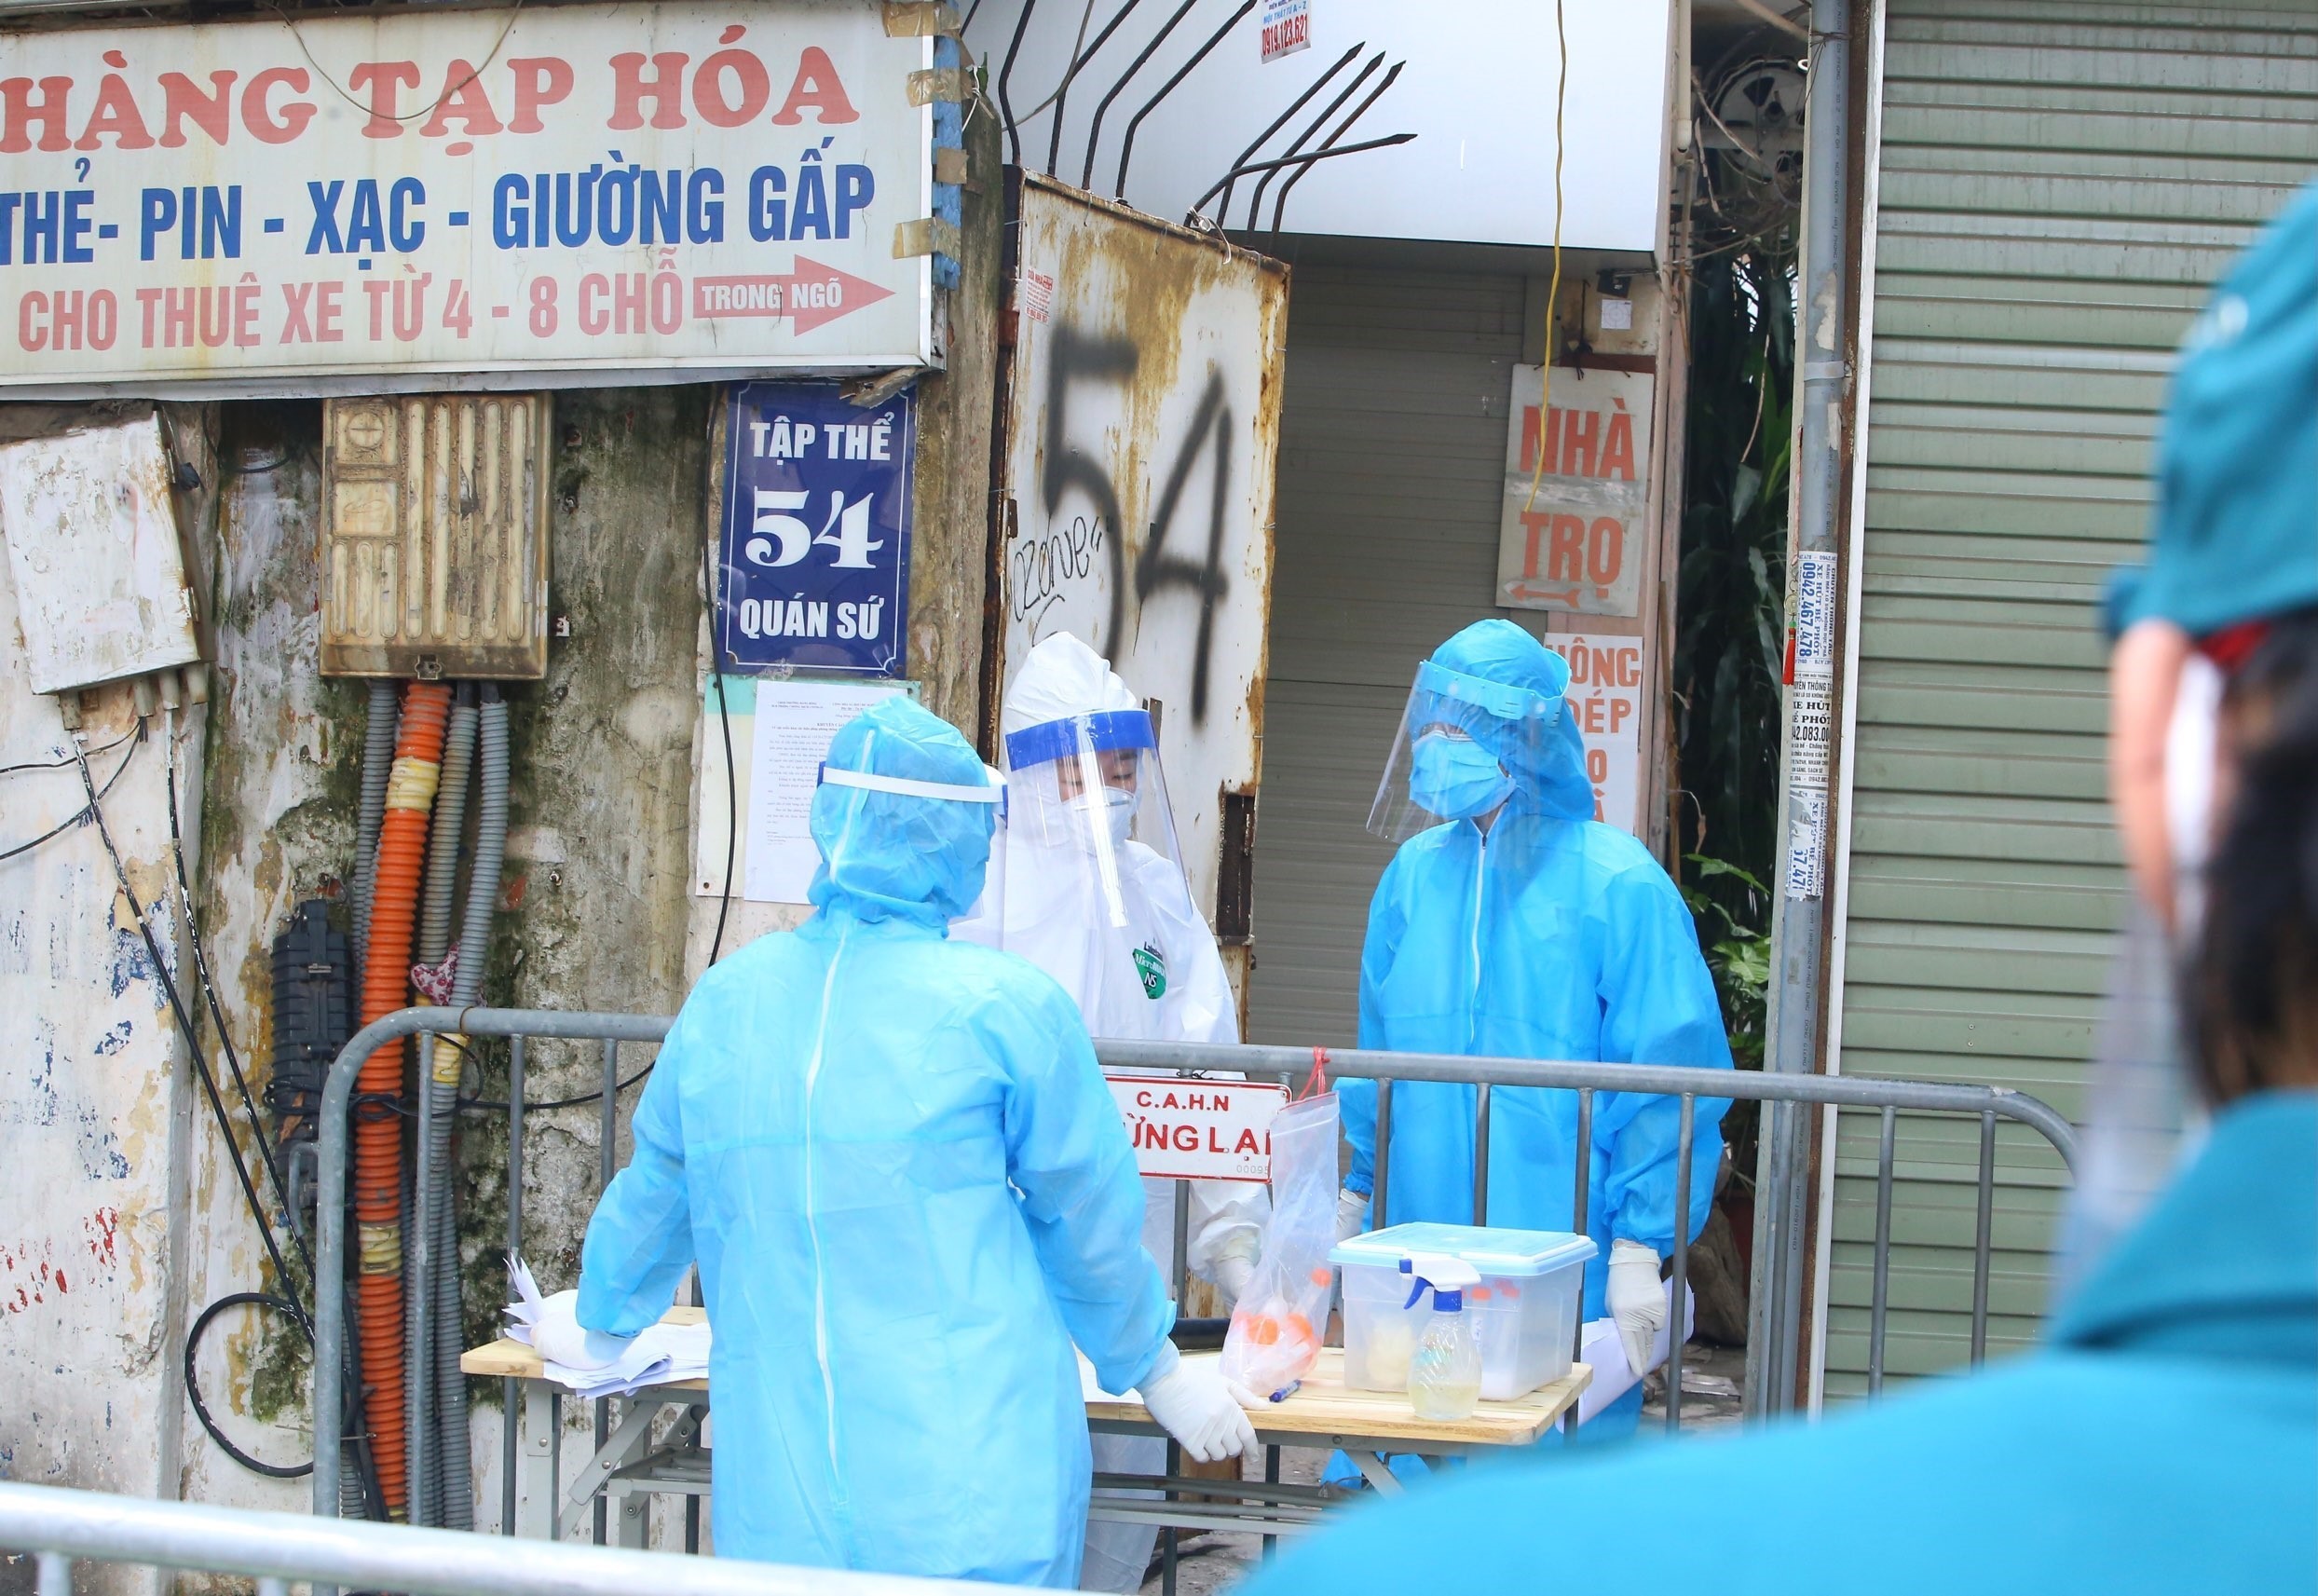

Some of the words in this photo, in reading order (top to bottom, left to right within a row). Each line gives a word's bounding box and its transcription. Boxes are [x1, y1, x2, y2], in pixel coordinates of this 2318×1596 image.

[1261, 13, 1308, 56] 0919.123.621
[0, 49, 318, 154] HÀNG
[348, 57, 575, 157] TẠP
[607, 24, 861, 130] HÓA
[140, 184, 242, 261] PIN
[305, 176, 426, 270] XẠC
[492, 149, 725, 250] GIƯỜNG
[748, 136, 875, 242] GẤP
[18, 289, 118, 352] CHO
[135, 271, 262, 349] THUÊ
[280, 281, 344, 345] XE
[361, 263, 431, 342] TỪ
[441, 280, 473, 339] 4
[528, 276, 559, 339] 8
[578, 247, 683, 336] CHỖ
[701, 283, 784, 311] TRONG
[791, 277, 842, 309] NGÕ
[749, 416, 816, 466] TẬP
[824, 411, 895, 462] THỂ
[1520, 398, 1636, 482] NHÀ
[745, 485, 884, 570] 54
[1519, 512, 1624, 599] TRỌ
[1817, 564, 1823, 580] XE
[739, 592, 828, 639] QUÁN
[837, 594, 885, 641] SỨ
[1799, 562, 1817, 657] 0942.467.478
[1144, 972, 1157, 988] NS
[1137, 1091, 1229, 1112] C.A.H.N
[1124, 1112, 1199, 1152] ỪNG
[1208, 1126, 1271, 1162] LẠI
